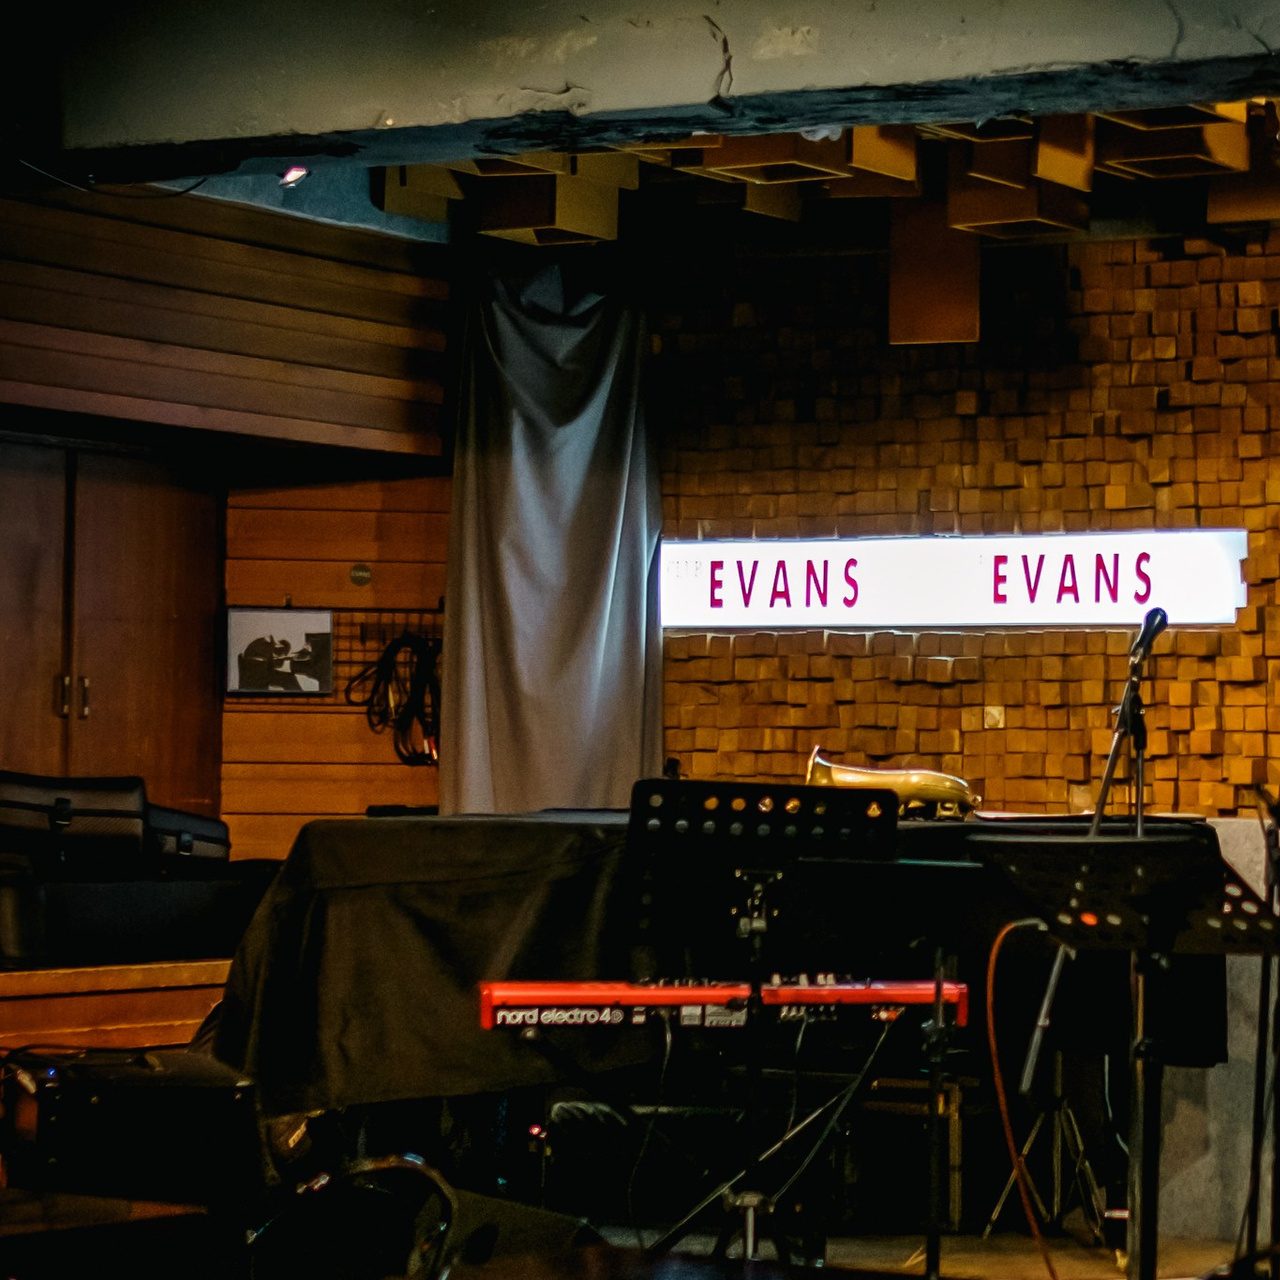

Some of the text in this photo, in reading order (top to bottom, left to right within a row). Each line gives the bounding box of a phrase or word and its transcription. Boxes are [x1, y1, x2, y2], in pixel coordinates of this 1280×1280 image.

[709, 551, 1153, 608] EVANS EVANS
[497, 1008, 539, 1024] nord
